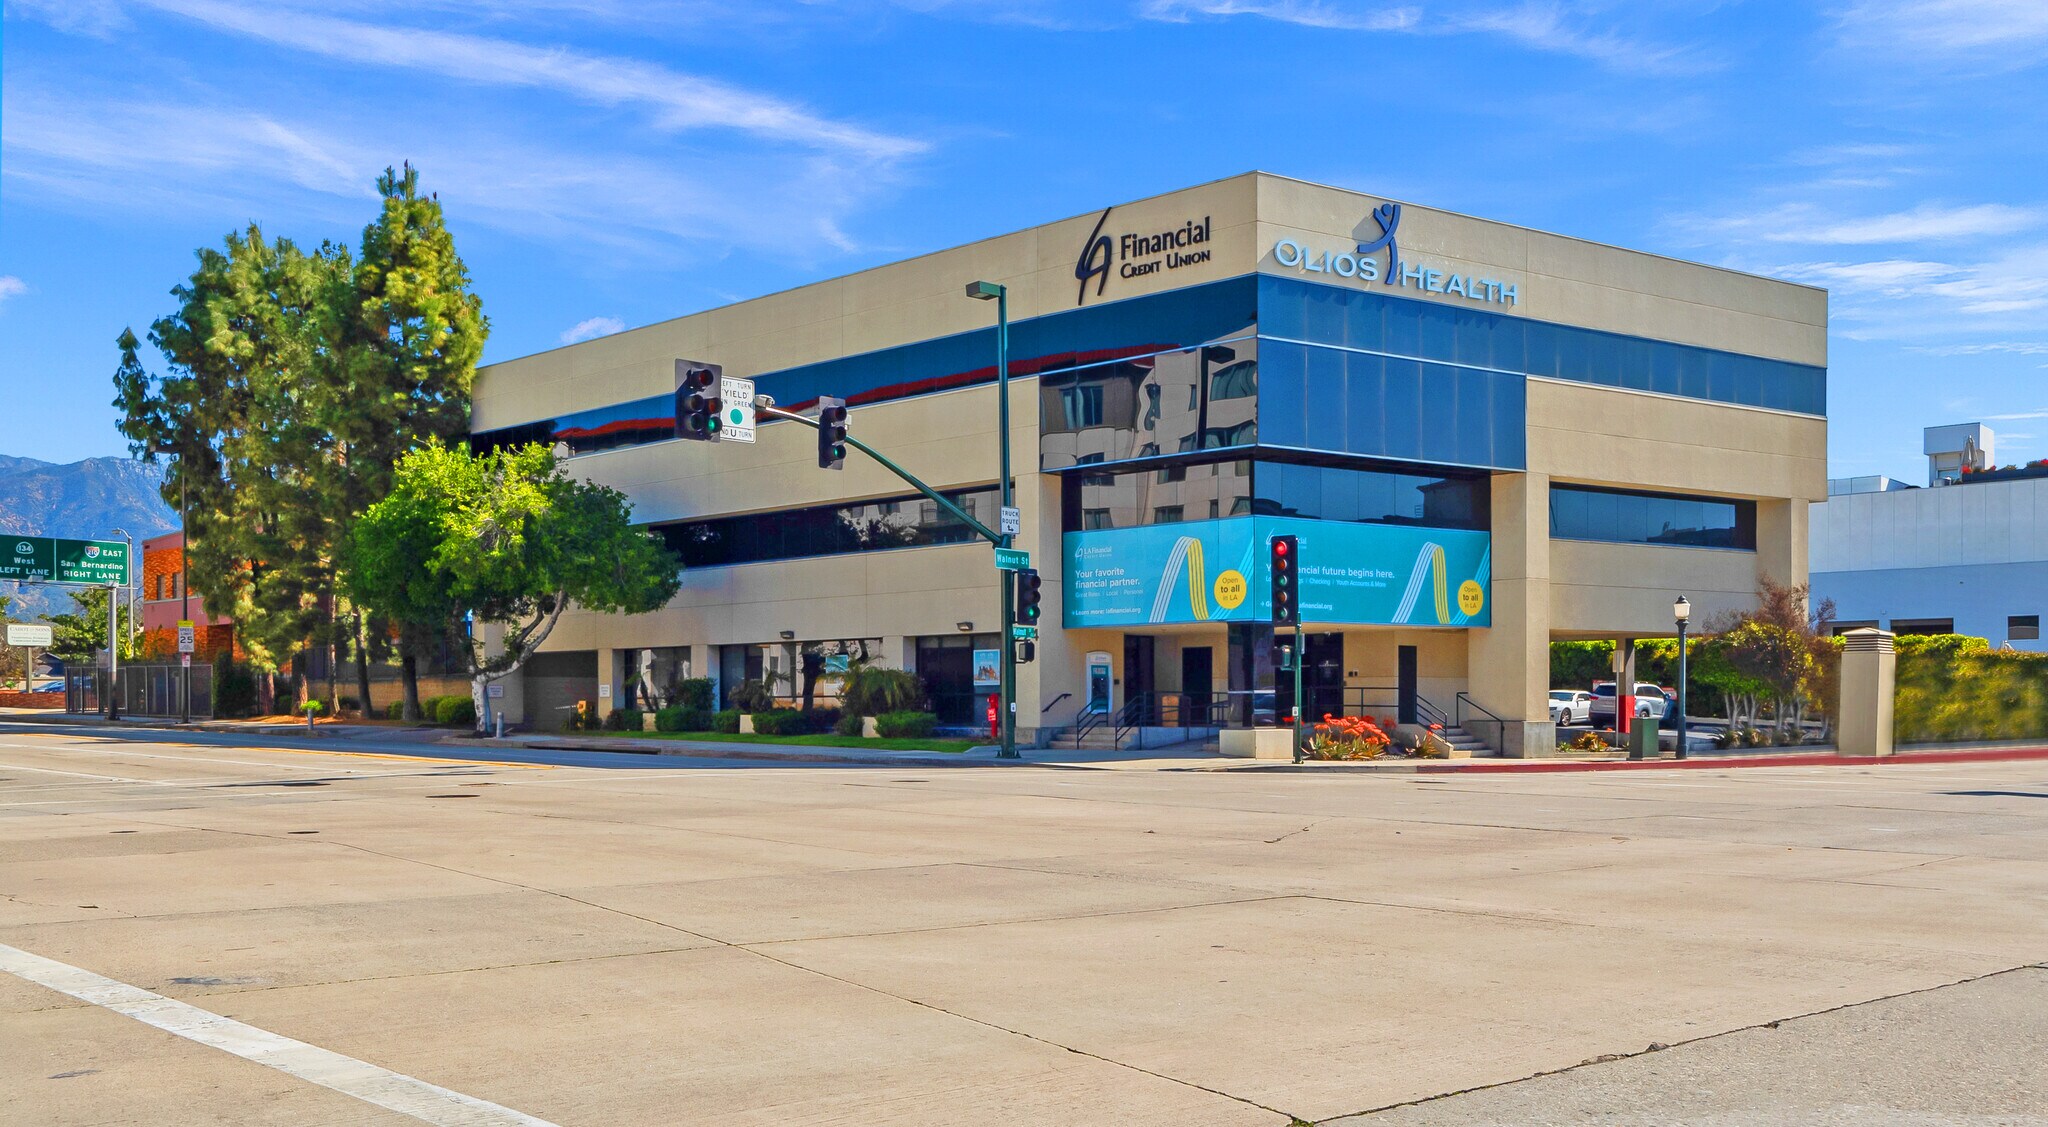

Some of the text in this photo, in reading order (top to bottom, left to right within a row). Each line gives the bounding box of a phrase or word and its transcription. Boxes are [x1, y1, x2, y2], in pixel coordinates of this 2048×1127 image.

[1121, 216, 1210, 260] Financial
[1121, 250, 1210, 278] CREDIT UNION
[1274, 239, 1518, 305] OLIOS HEALTH
[731, 429, 736, 437] U
[997, 554, 1028, 565] Walnut St
[82, 561, 123, 570] Bernardino
[1076, 568, 1124, 578] Your favorite
[1322, 566, 1346, 576] future
[1348, 568, 1373, 578] begins
[1376, 569, 1395, 578] here.
[1076, 578, 1140, 588] financial partner.
